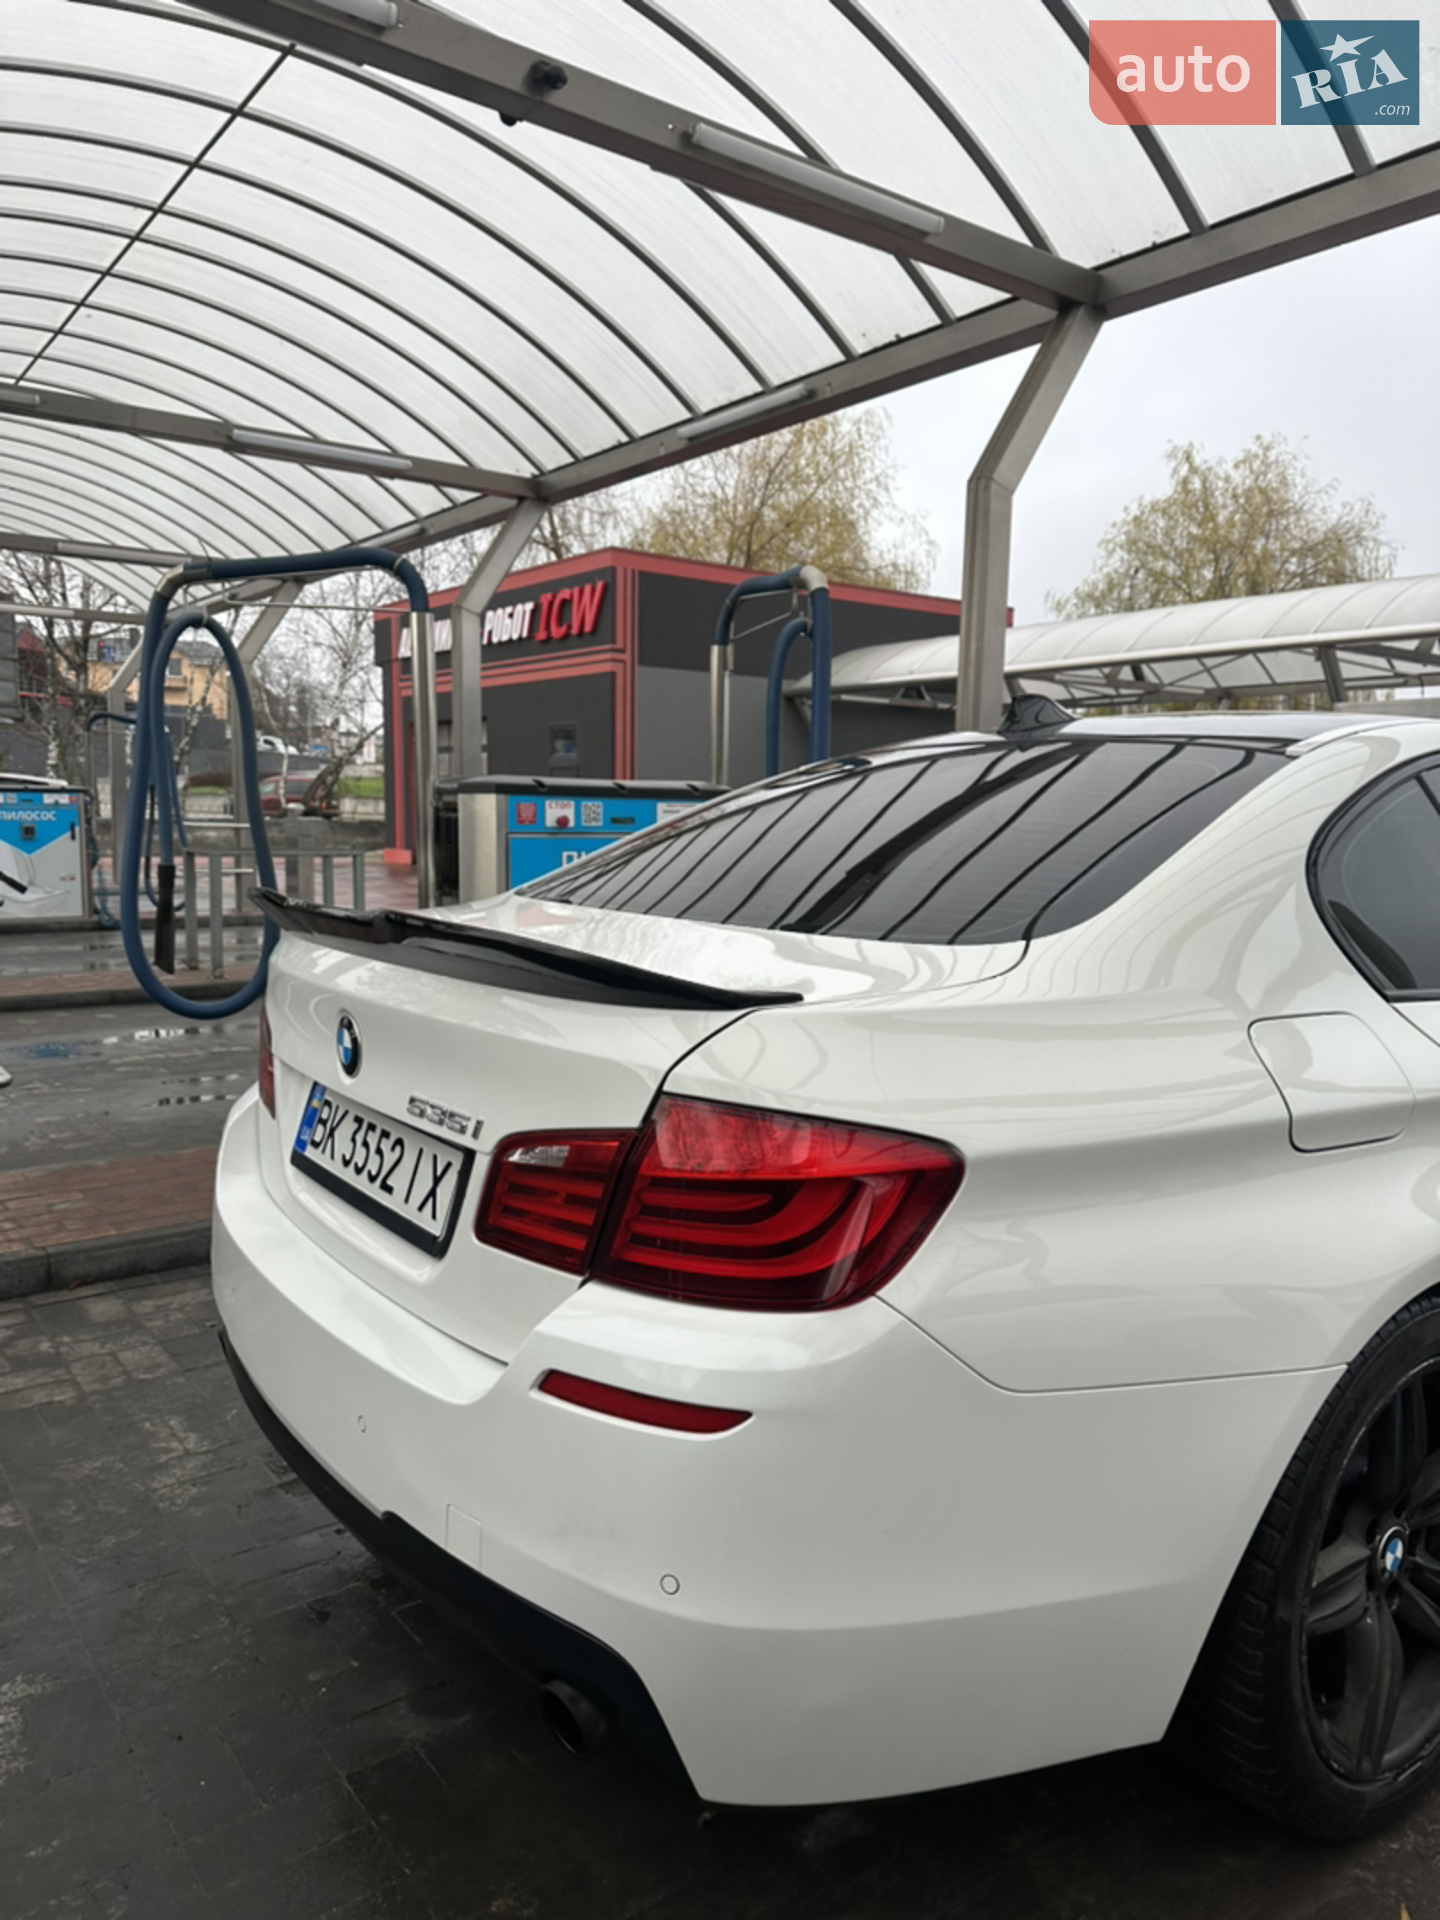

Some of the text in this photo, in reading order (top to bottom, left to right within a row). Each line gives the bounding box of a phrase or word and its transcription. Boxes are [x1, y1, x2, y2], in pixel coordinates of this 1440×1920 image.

[534, 580, 607, 641] ICW
[309, 1098, 453, 1221] BK 3552 IX
